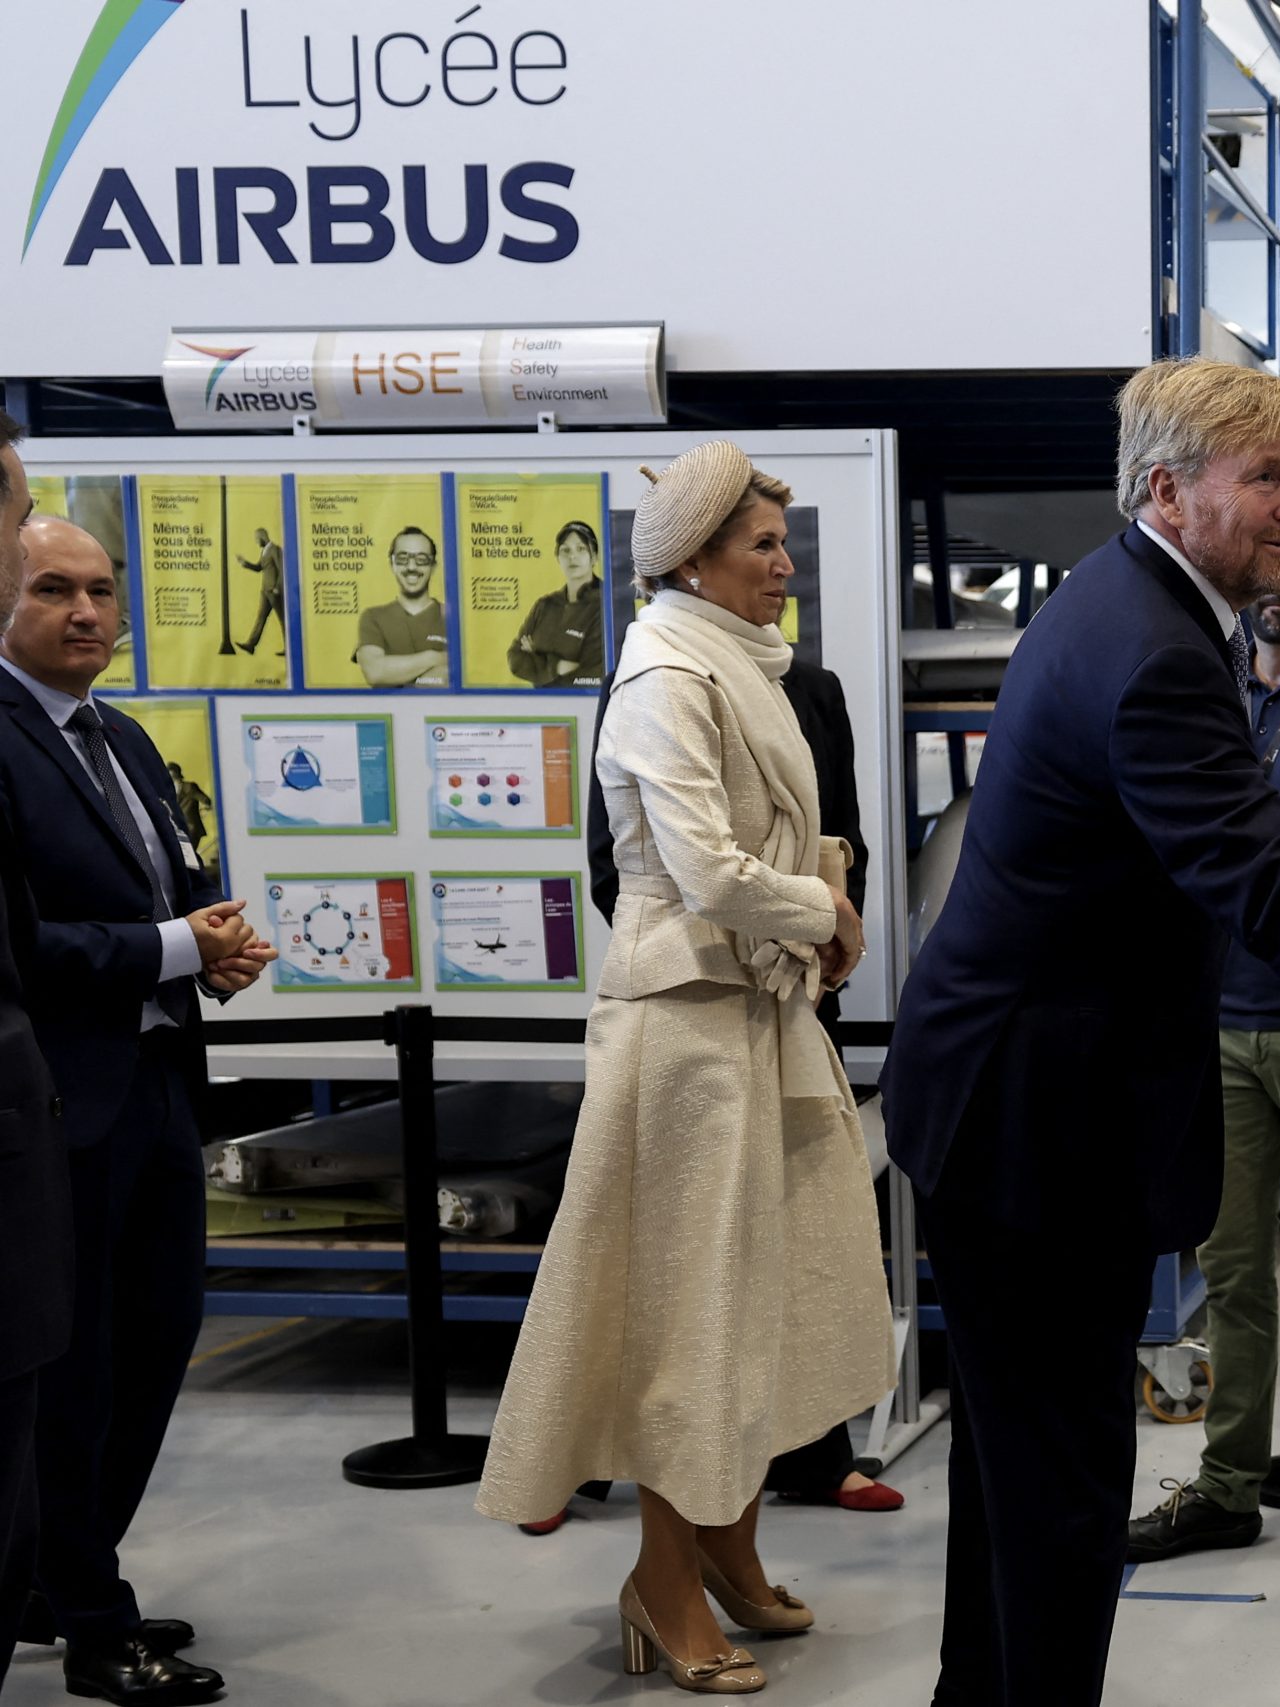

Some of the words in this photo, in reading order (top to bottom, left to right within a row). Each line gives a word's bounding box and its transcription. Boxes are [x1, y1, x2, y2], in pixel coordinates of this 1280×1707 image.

[241, 4, 567, 141] Lycée
[63, 161, 579, 266] AIRBUS
[512, 336, 562, 351] Health
[352, 352, 463, 395] HSE
[510, 358, 559, 377] Safety
[243, 360, 310, 388] Lycée
[513, 384, 609, 401] Environment
[215, 391, 317, 411] AIRBUS
[153, 523, 190, 534] Même
[193, 523, 203, 534] si
[312, 523, 349, 534] Même
[352, 523, 363, 534] si
[471, 522, 508, 534] Même
[511, 523, 522, 533] si
[153, 537, 183, 546] vous
[187, 535, 212, 546] êtes
[312, 538, 344, 547] votre
[347, 536, 373, 547] look
[471, 537, 502, 546] vous
[505, 537, 534, 546] avez
[154, 549, 203, 558] souvent
[312, 550, 328, 558] en
[331, 548, 367, 561] prend
[471, 548, 483, 558] la
[486, 547, 509, 558] tête
[511, 548, 541, 558] dure
[154, 560, 210, 570] connecté
[313, 562, 329, 571] un
[332, 562, 364, 573] coup
